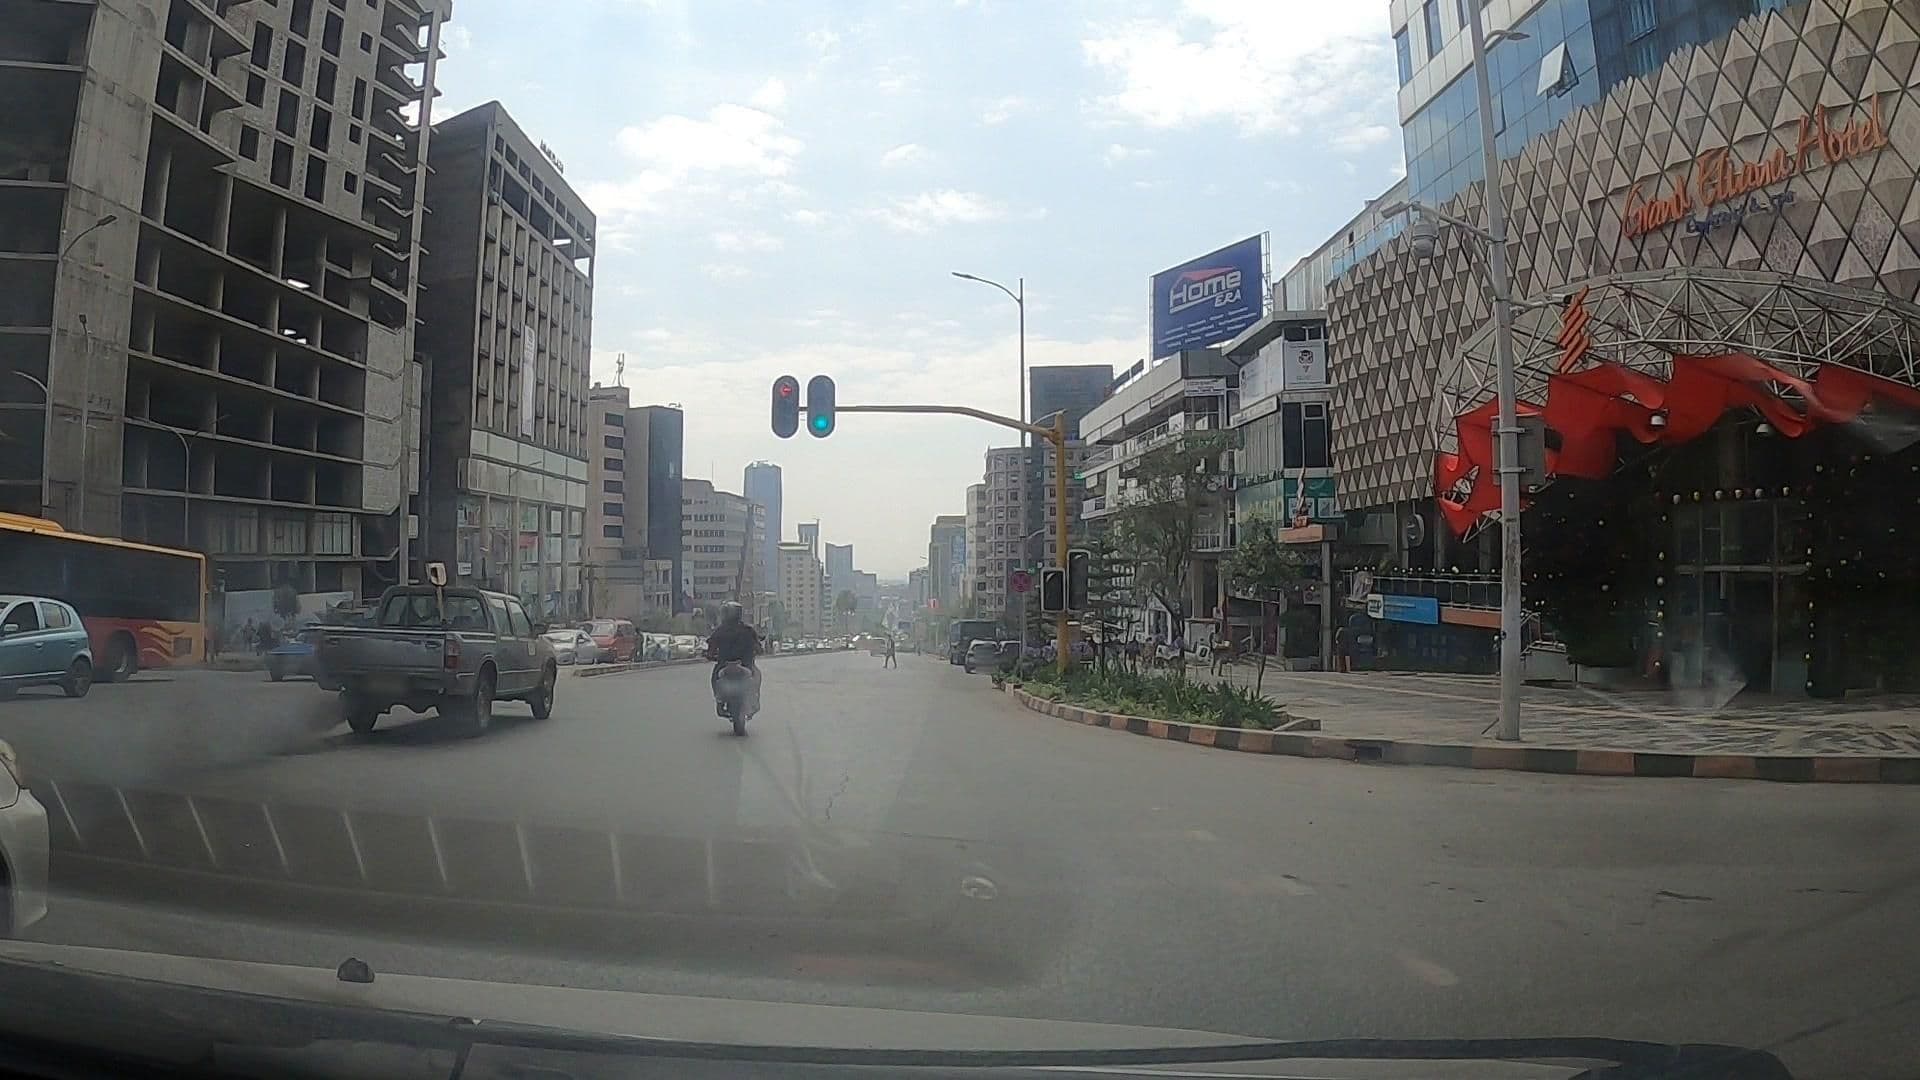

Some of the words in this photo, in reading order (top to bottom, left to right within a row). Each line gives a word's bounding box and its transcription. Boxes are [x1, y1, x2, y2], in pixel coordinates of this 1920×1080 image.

[1623, 175, 1692, 238] Grand
[1696, 147, 1788, 206] Eliana
[1795, 91, 1888, 172] Hotel
[1169, 270, 1241, 306] Home
[1214, 289, 1242, 308] ERA
